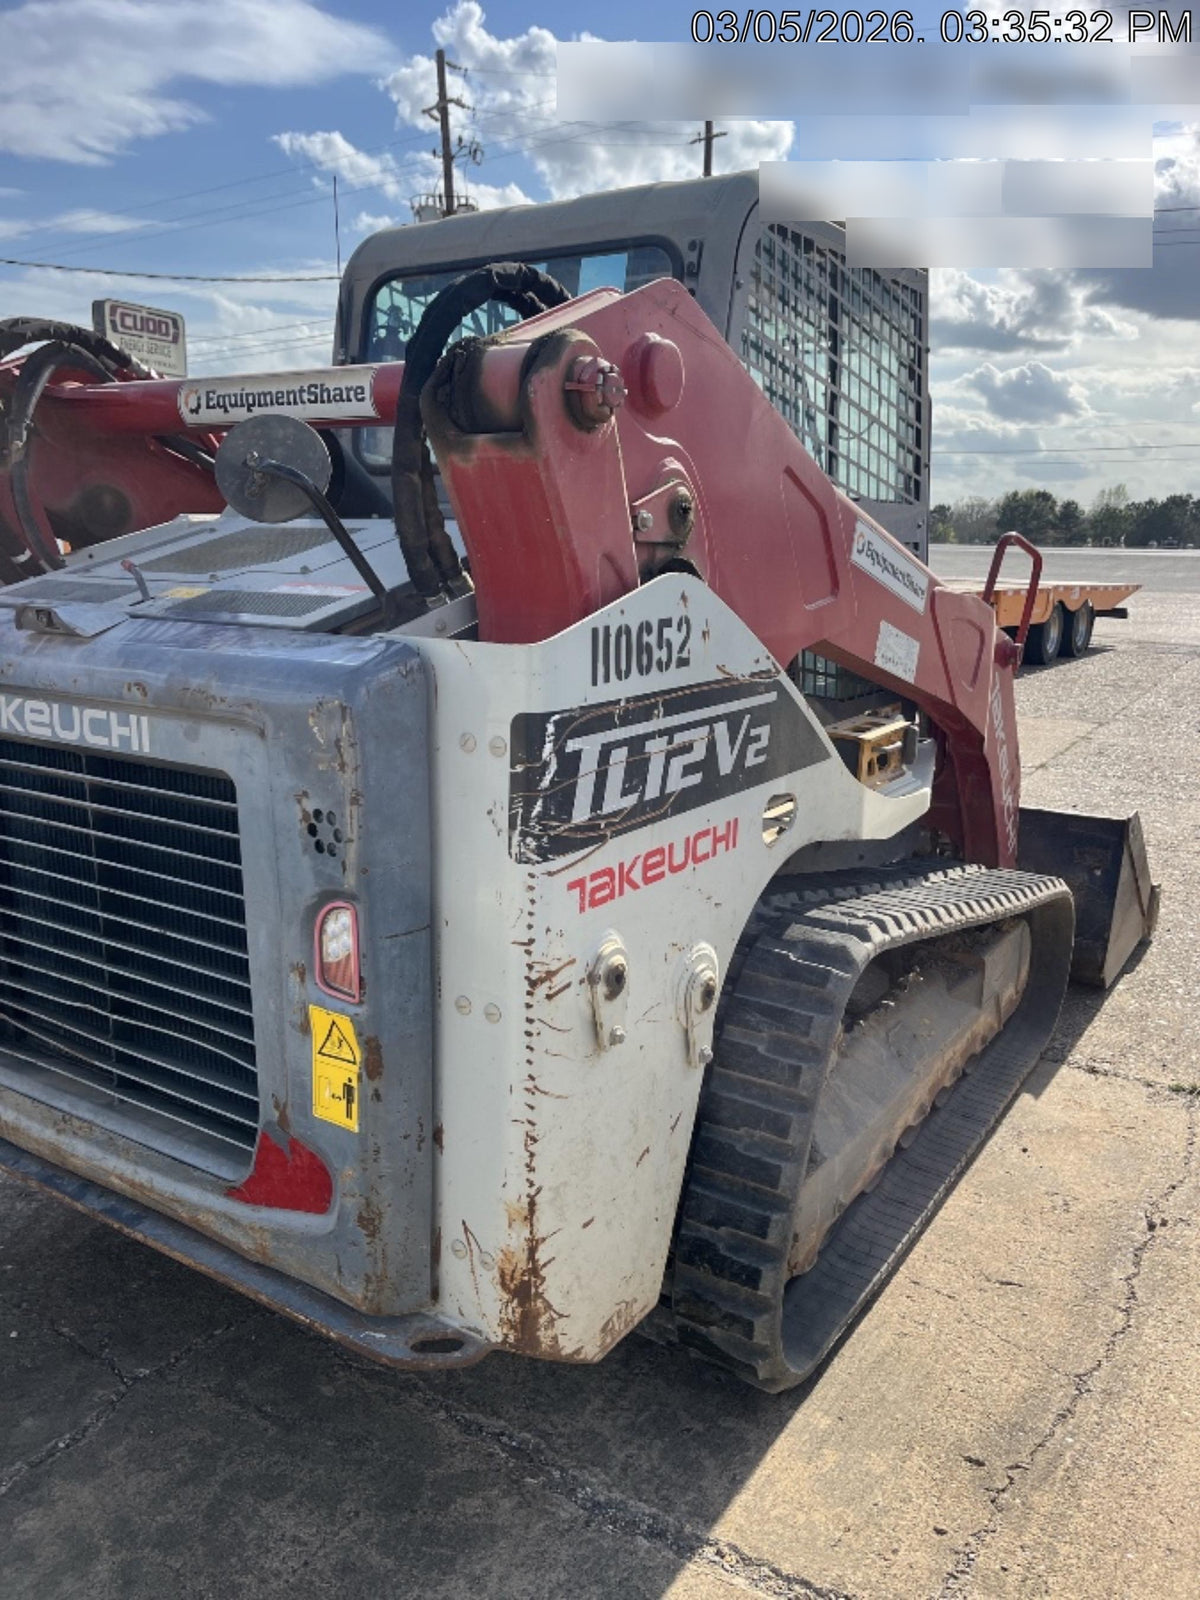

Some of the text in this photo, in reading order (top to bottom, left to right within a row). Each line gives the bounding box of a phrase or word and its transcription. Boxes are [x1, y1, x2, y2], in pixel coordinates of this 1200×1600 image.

[205, 383, 366, 414] EquipmentShare
[865, 539, 926, 602] EquipmentShare
[591, 614, 692, 687] 110652
